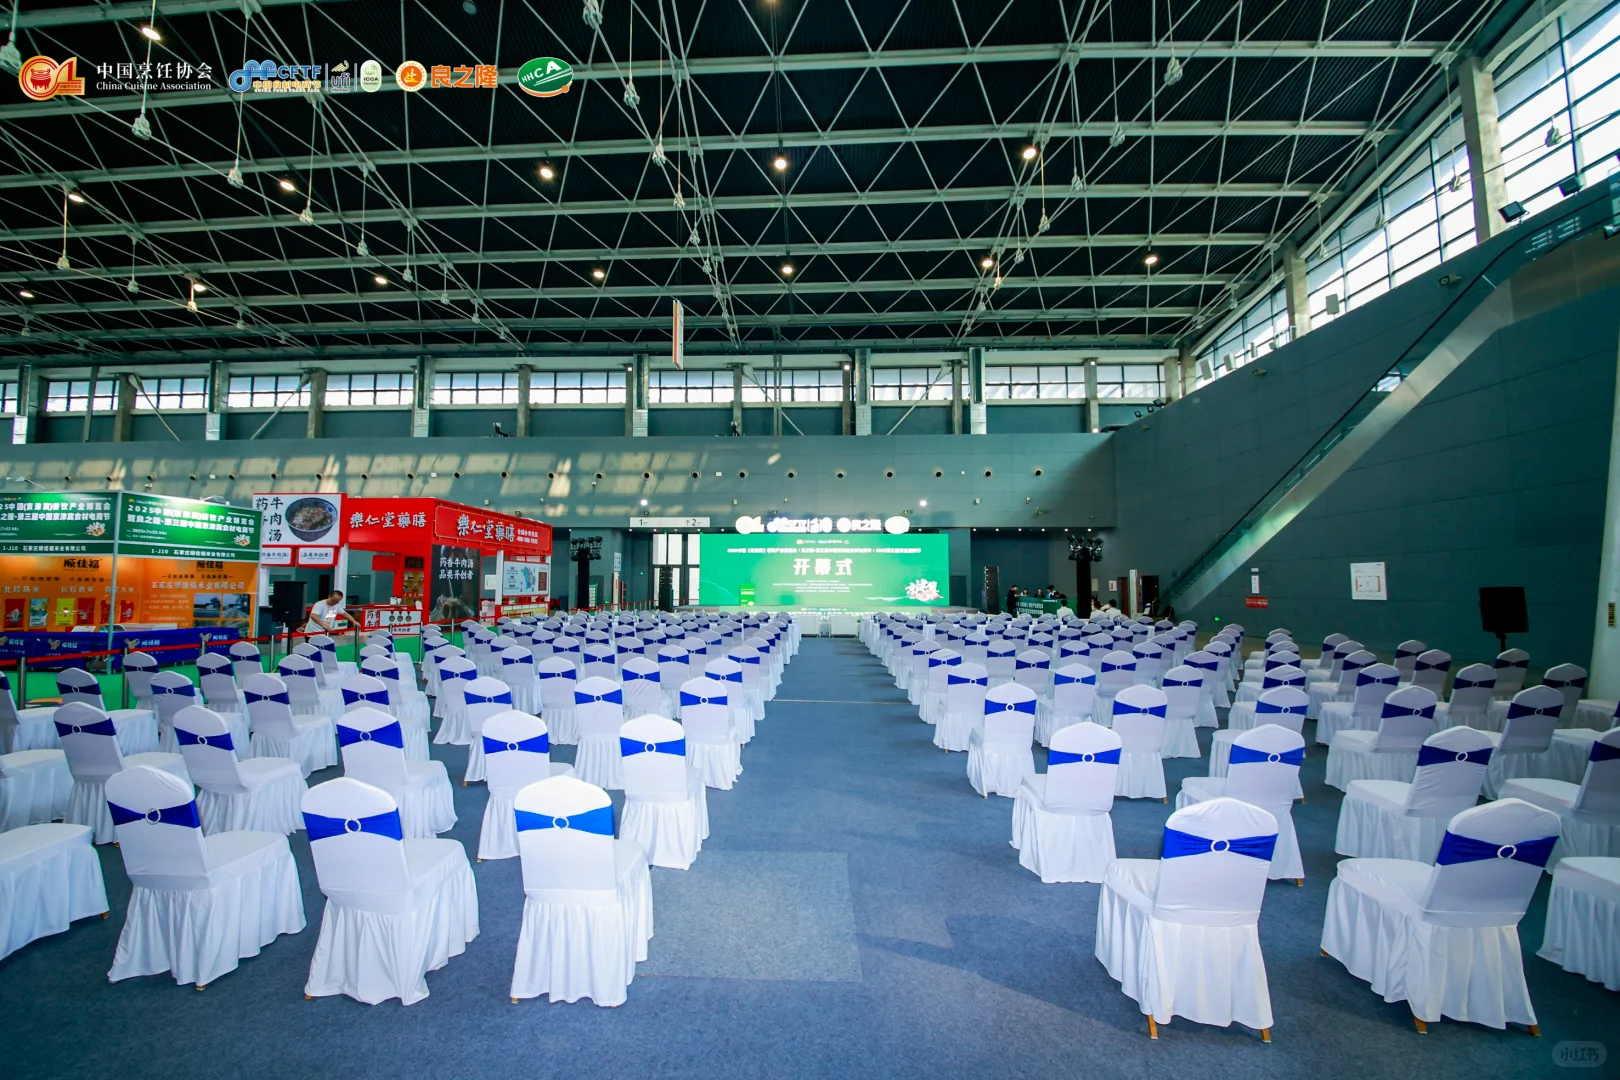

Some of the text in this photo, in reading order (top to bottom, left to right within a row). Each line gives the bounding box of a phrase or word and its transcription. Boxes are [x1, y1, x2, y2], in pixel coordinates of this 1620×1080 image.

[269, 496, 283, 542] 牛肉汤
[63, 558, 100, 569] 顺佳福
[793, 558, 852, 576] 开幕式
